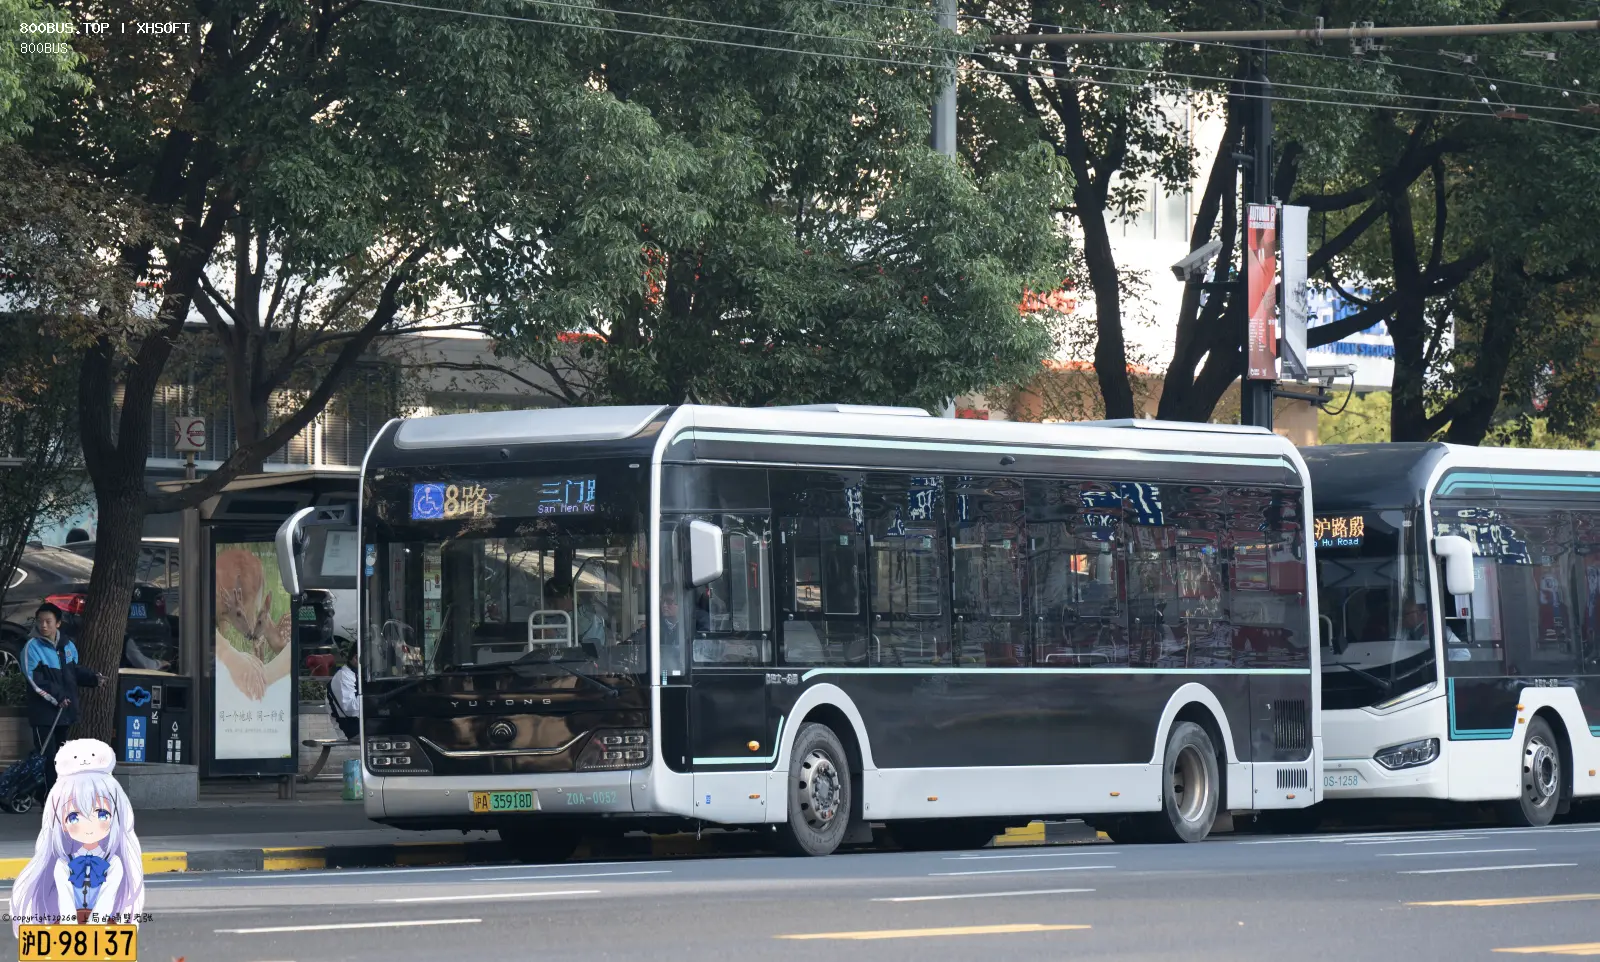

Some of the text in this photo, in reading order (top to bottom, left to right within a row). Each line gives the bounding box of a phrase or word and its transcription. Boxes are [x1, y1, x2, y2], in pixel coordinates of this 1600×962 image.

[538, 505, 556, 514] San
[1337, 537, 1359, 546] Road
[451, 698, 551, 708] YUTONG
